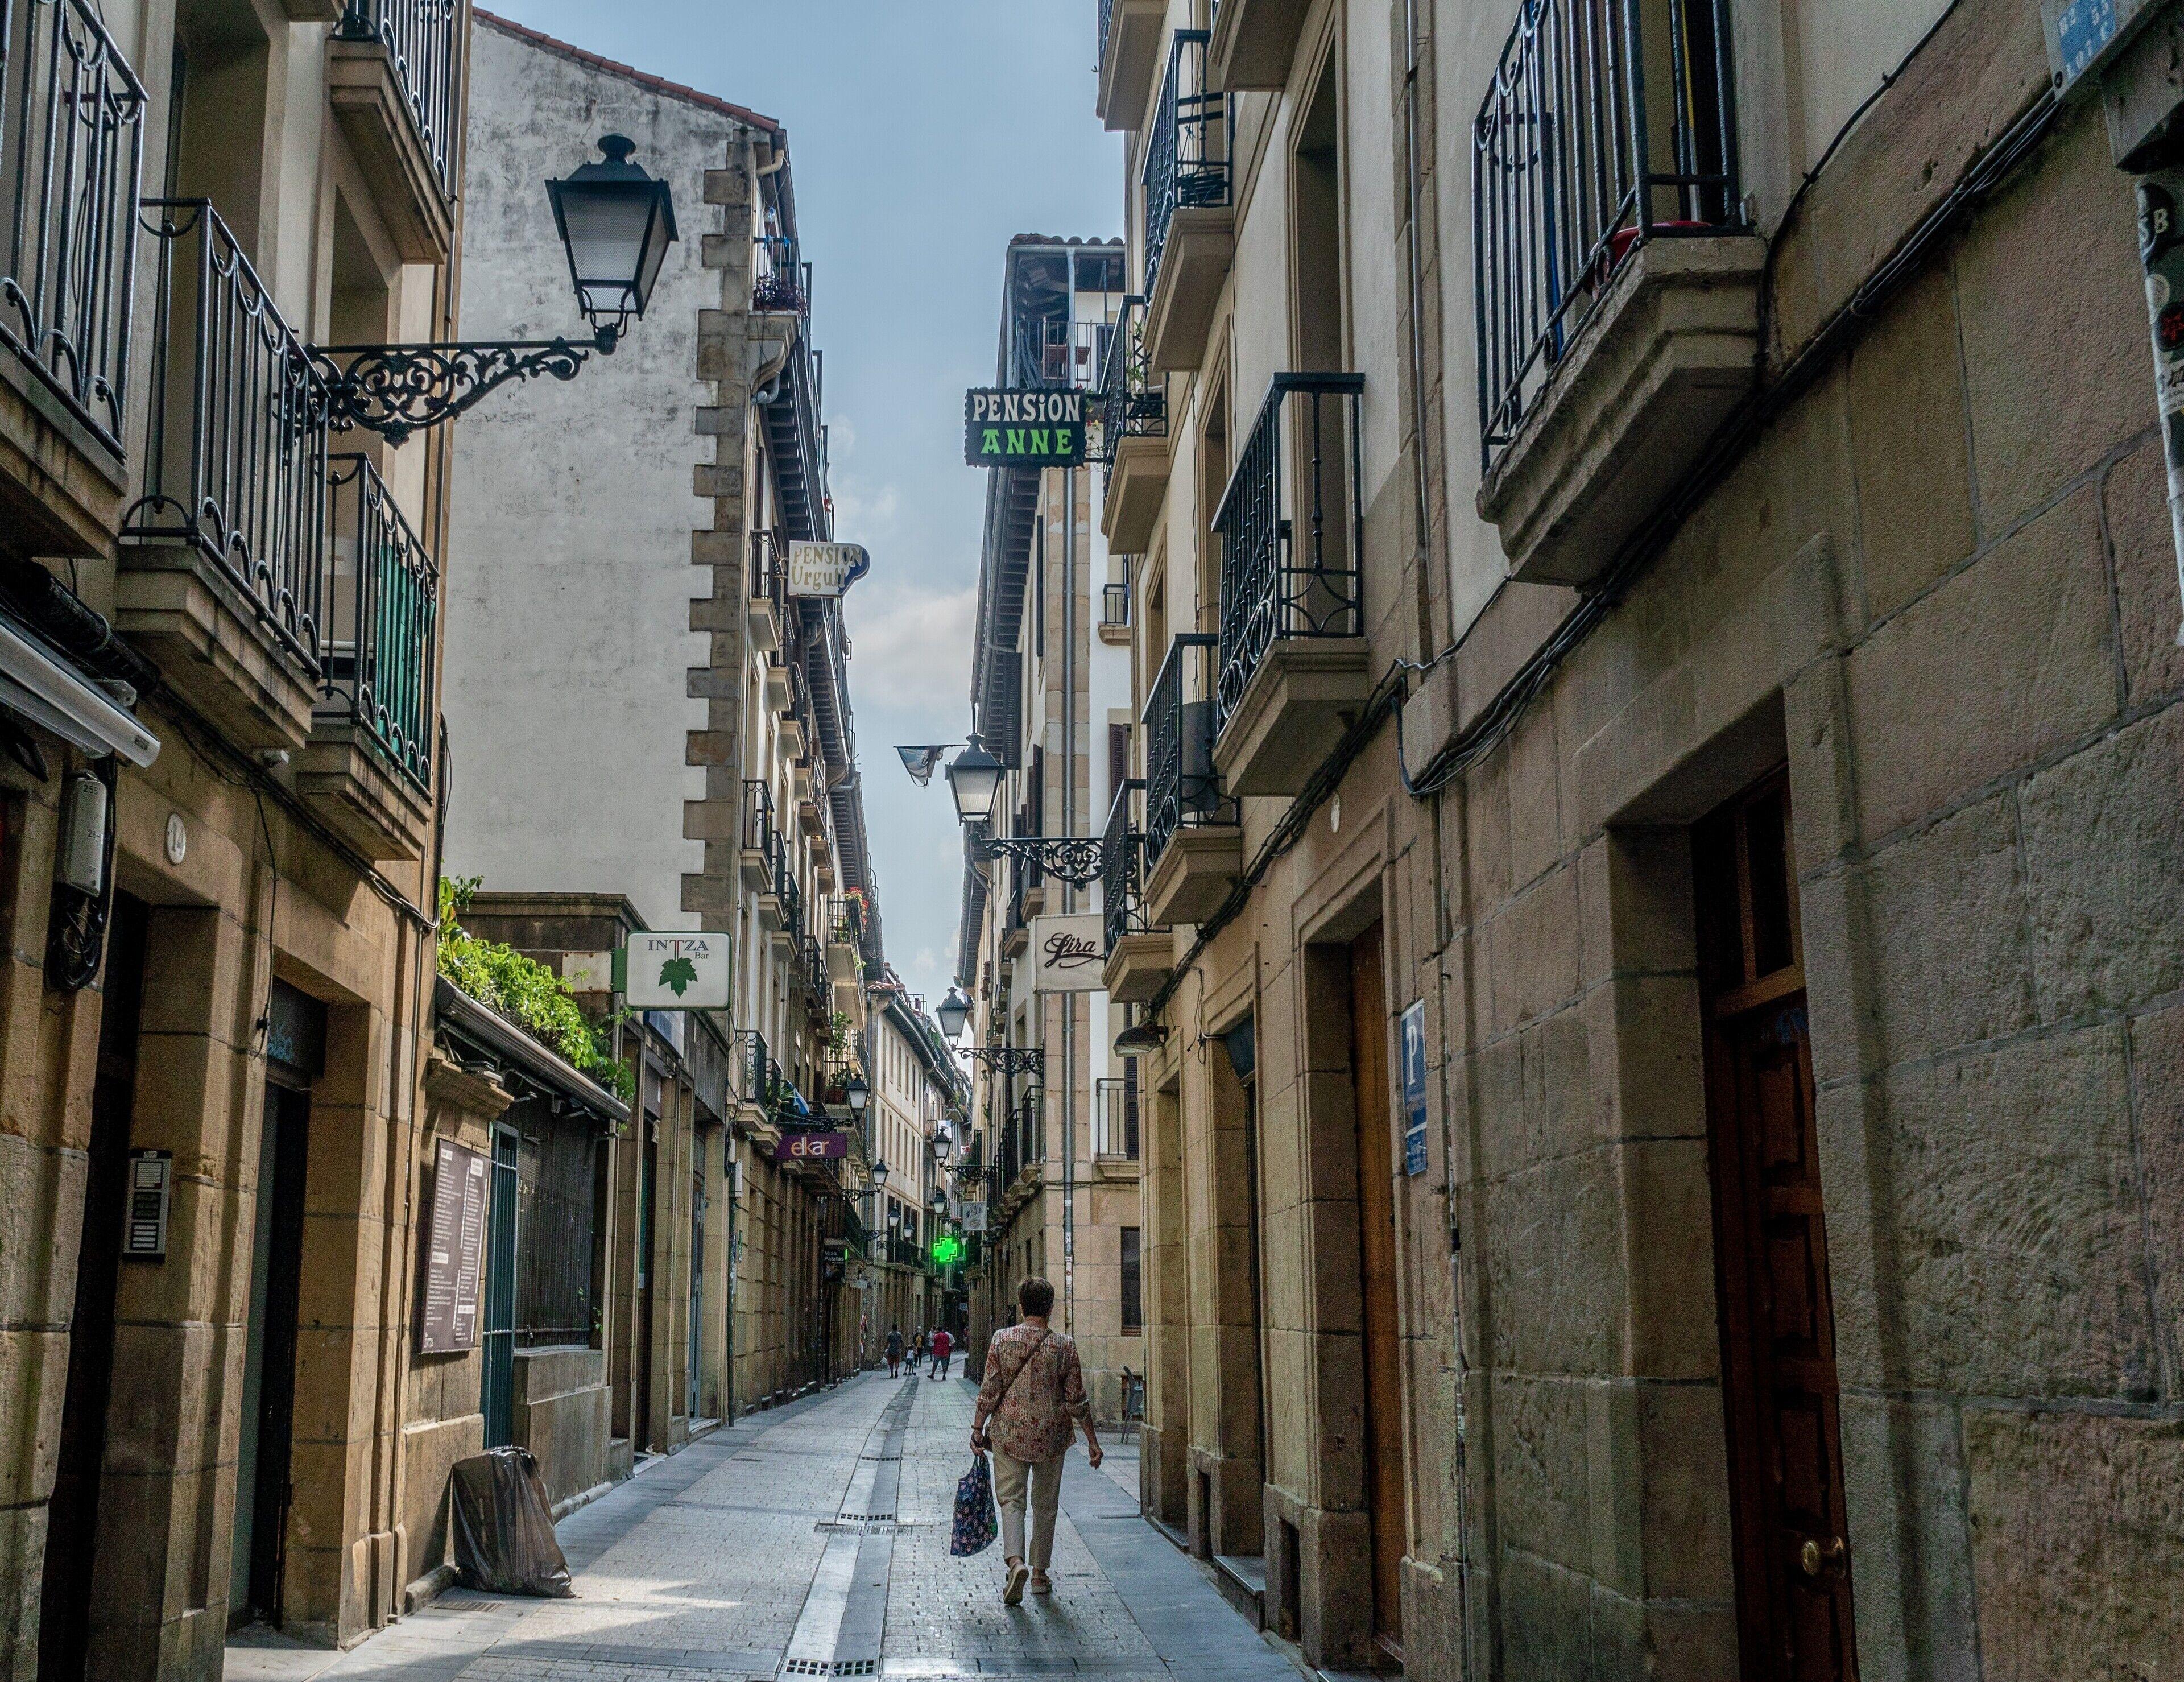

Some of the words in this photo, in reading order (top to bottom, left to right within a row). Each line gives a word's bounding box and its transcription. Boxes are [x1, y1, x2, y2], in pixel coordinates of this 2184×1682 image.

[980, 429, 1073, 454] ANNE
[647, 940, 709, 957] INTZA
[791, 1137, 830, 1156] elkar
